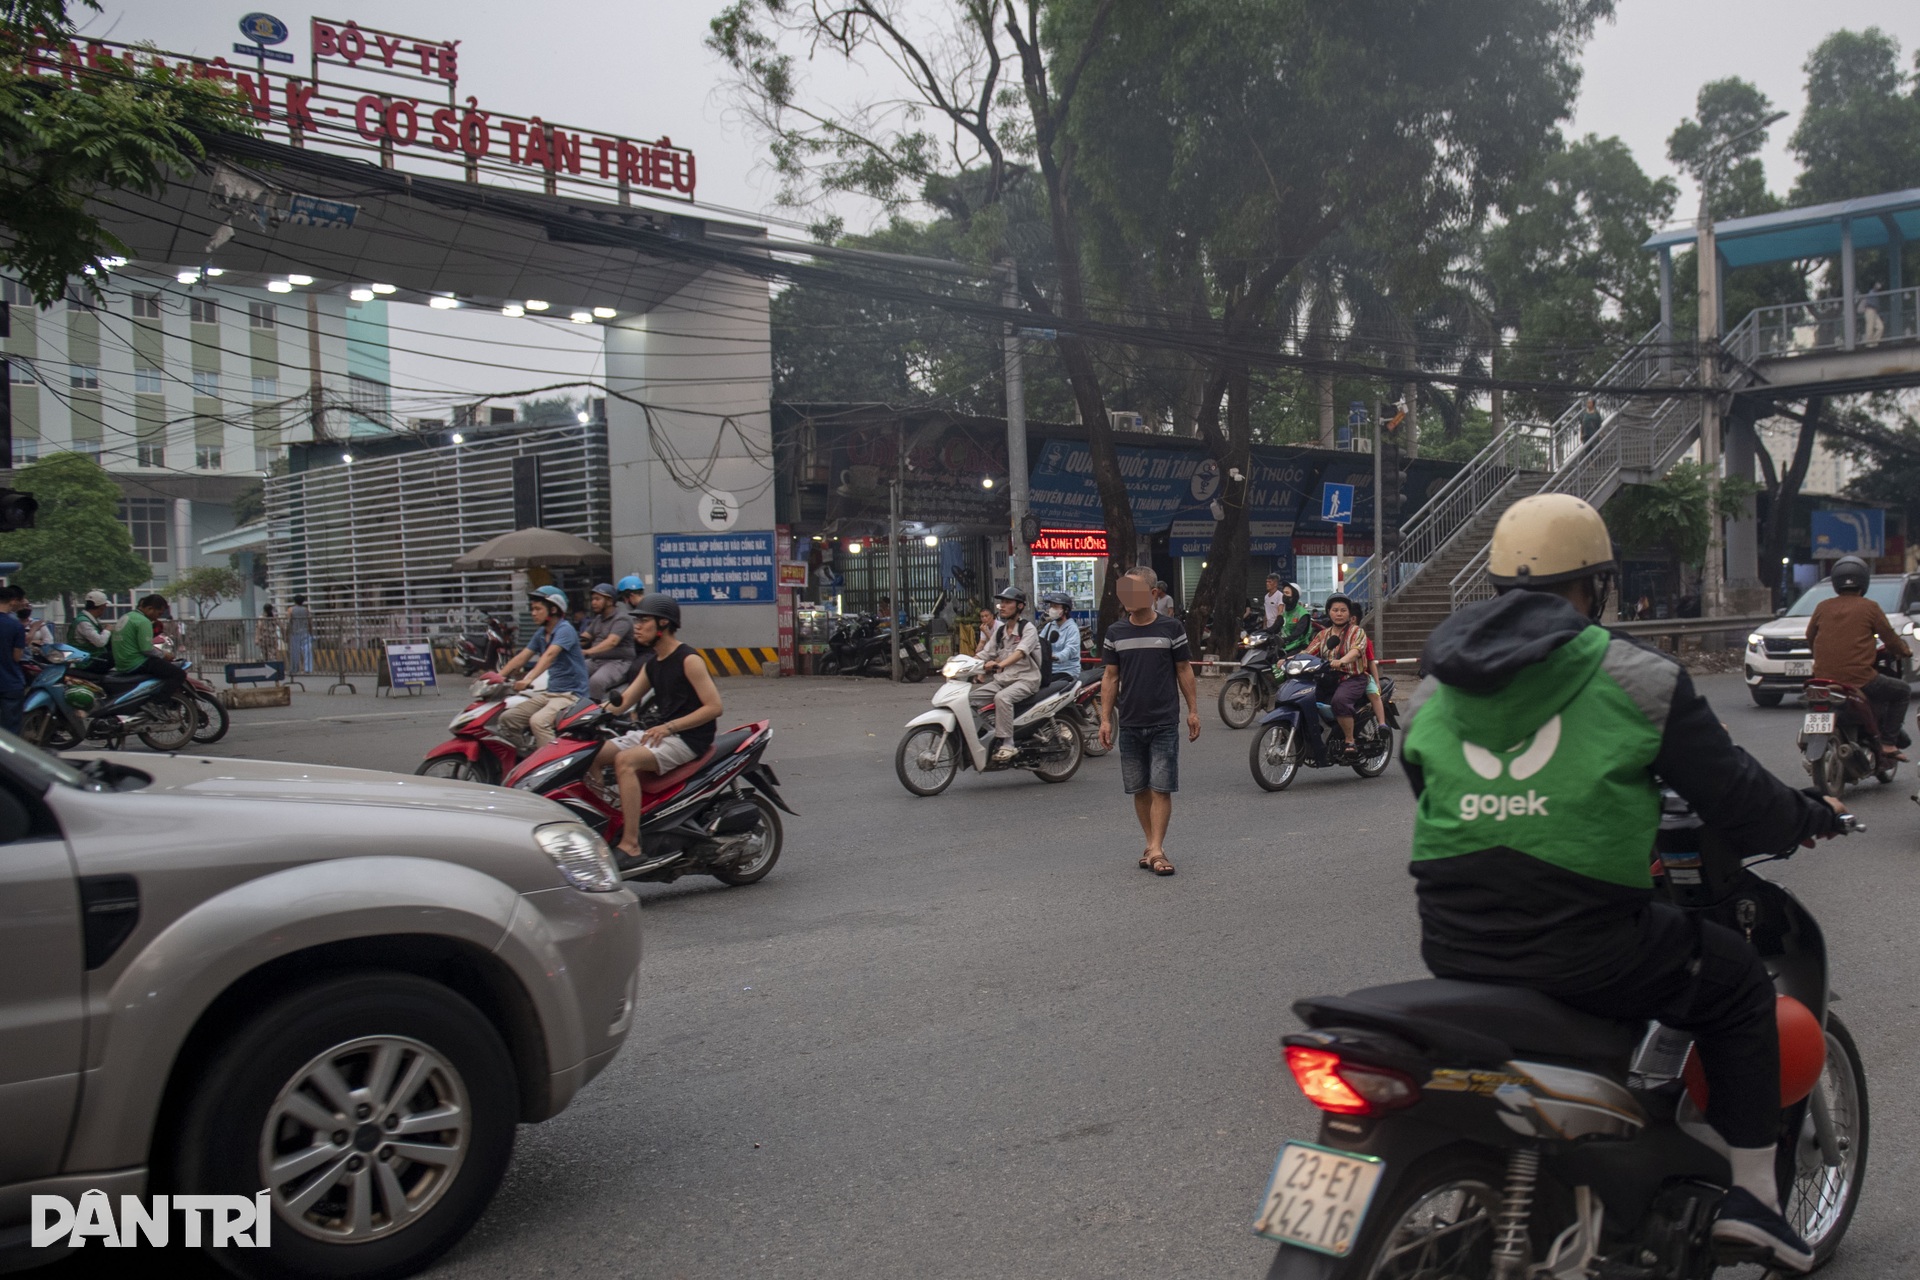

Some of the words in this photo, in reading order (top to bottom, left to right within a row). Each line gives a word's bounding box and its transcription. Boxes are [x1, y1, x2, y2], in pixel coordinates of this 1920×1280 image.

[312, 20, 366, 67] BỘ
[375, 36, 401, 68] Y
[413, 40, 462, 82] TẾ
[285, 81, 320, 132] K
[355, 95, 419, 147] CƠ
[432, 95, 490, 158] SỞ
[501, 115, 581, 175] TÂN
[592, 135, 697, 194] TRIỀU
[1460, 789, 1550, 821] gojek
[1285, 1152, 1364, 1203] 23-E1
[1263, 1191, 1356, 1246] 242.16
